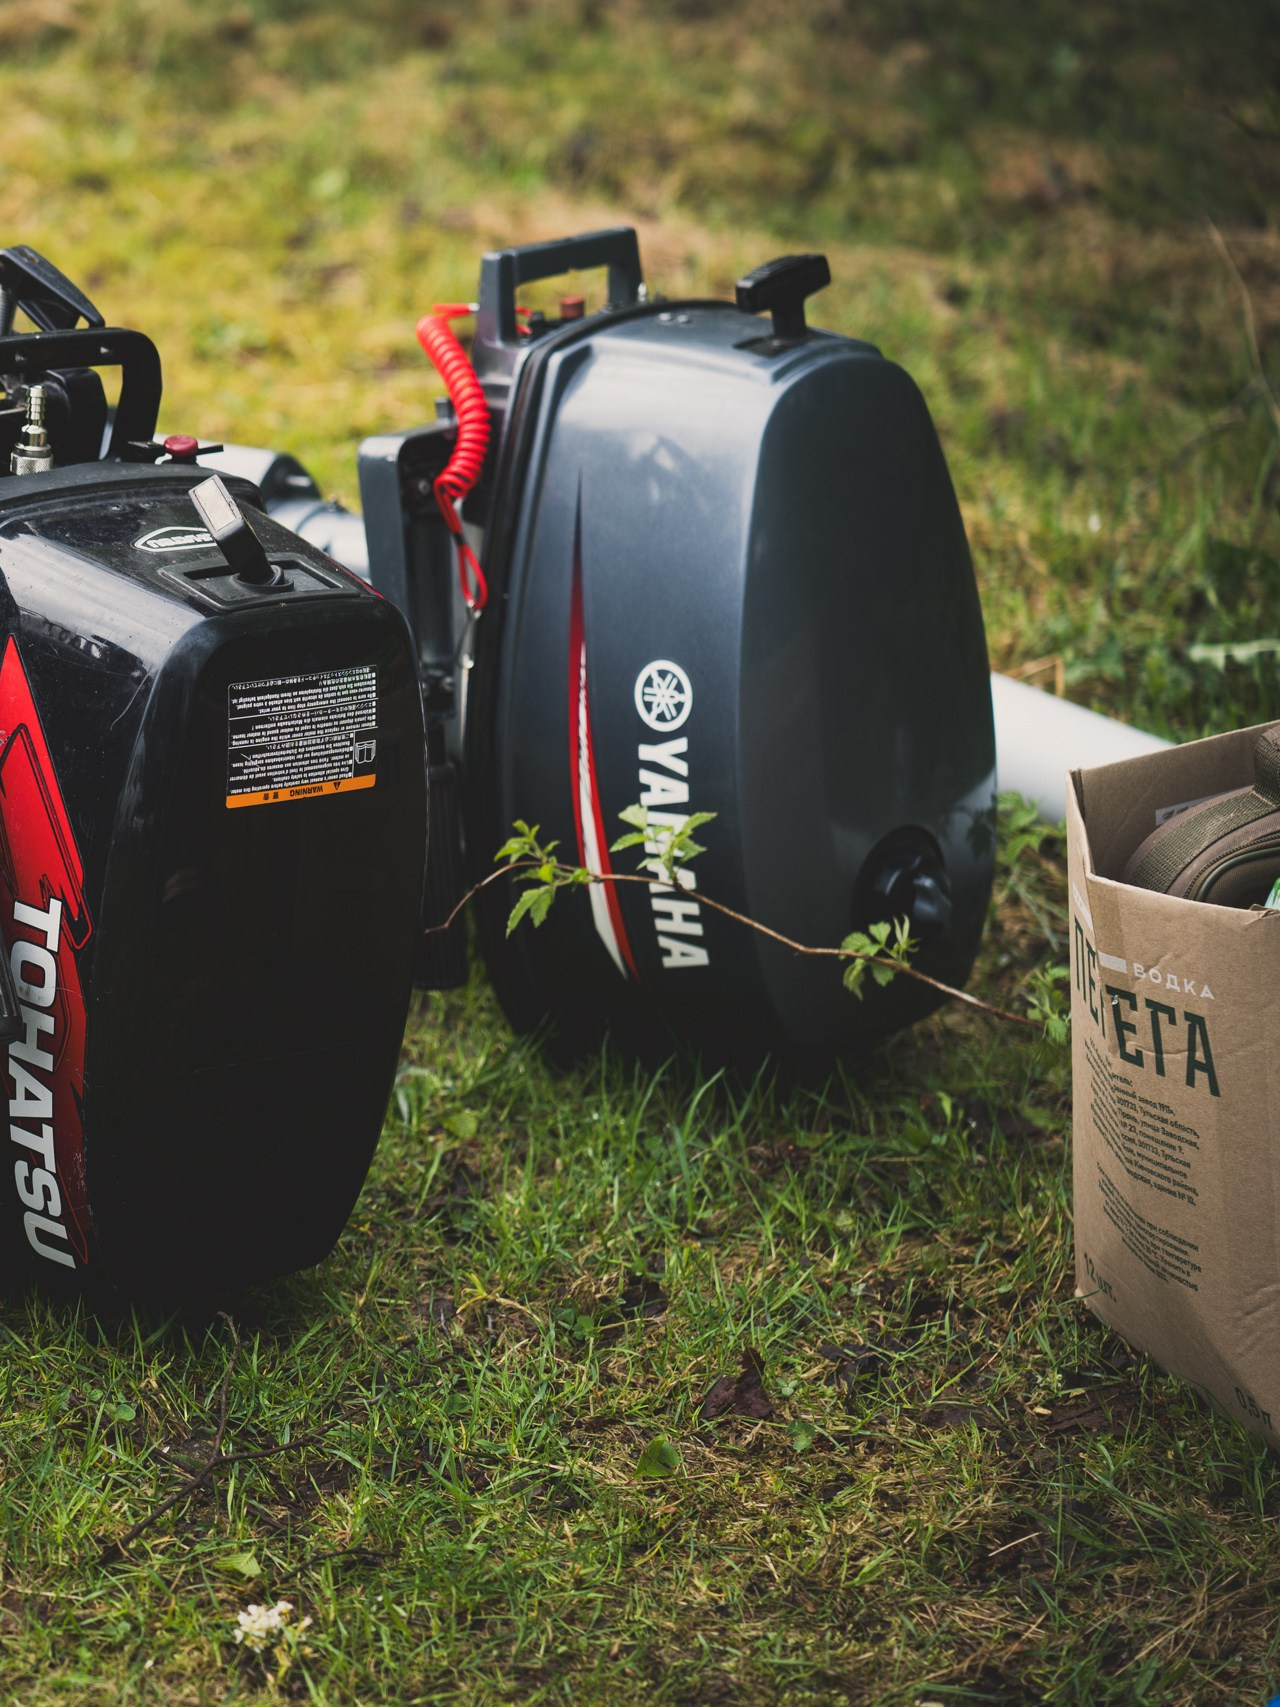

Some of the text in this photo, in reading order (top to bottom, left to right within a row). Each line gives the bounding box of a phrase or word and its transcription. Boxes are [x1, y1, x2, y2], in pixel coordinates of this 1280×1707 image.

[289, 785, 323, 796] WARNING
[1132, 962, 1215, 1000] ВОДКА
[8, 897, 77, 1269] TOHATSU
